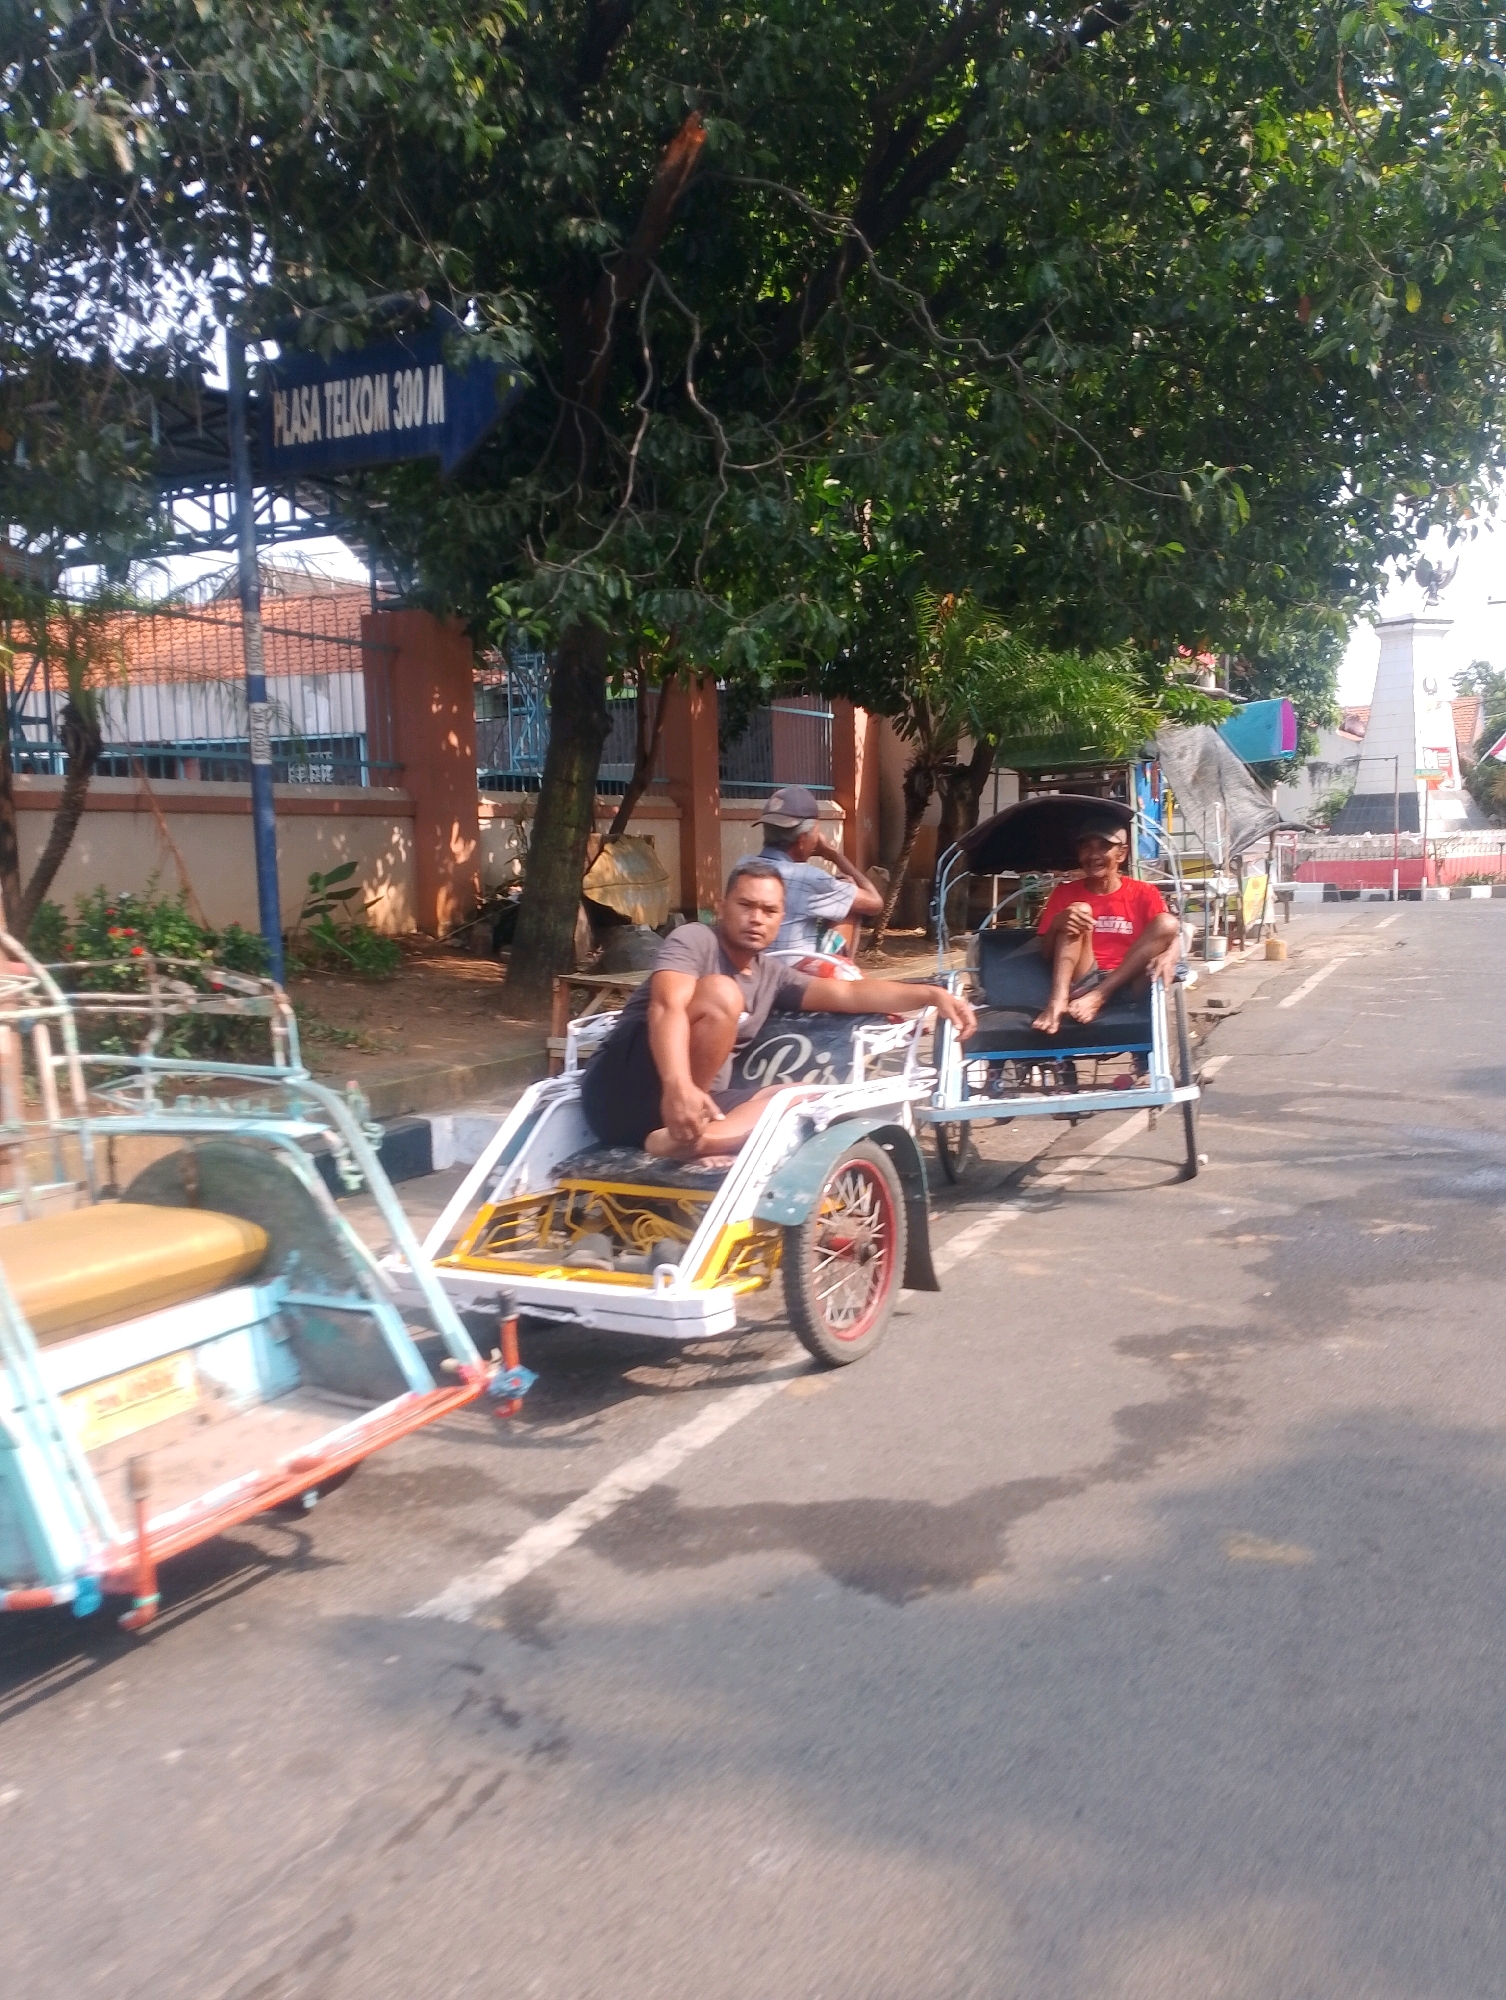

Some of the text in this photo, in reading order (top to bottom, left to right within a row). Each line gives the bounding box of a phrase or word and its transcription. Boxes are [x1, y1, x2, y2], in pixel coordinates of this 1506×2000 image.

[273, 363, 445, 448] PLASA TELKOM 300 M
[246, 618, 258, 634] WC
[252, 708, 266, 760] SEDOT WC
